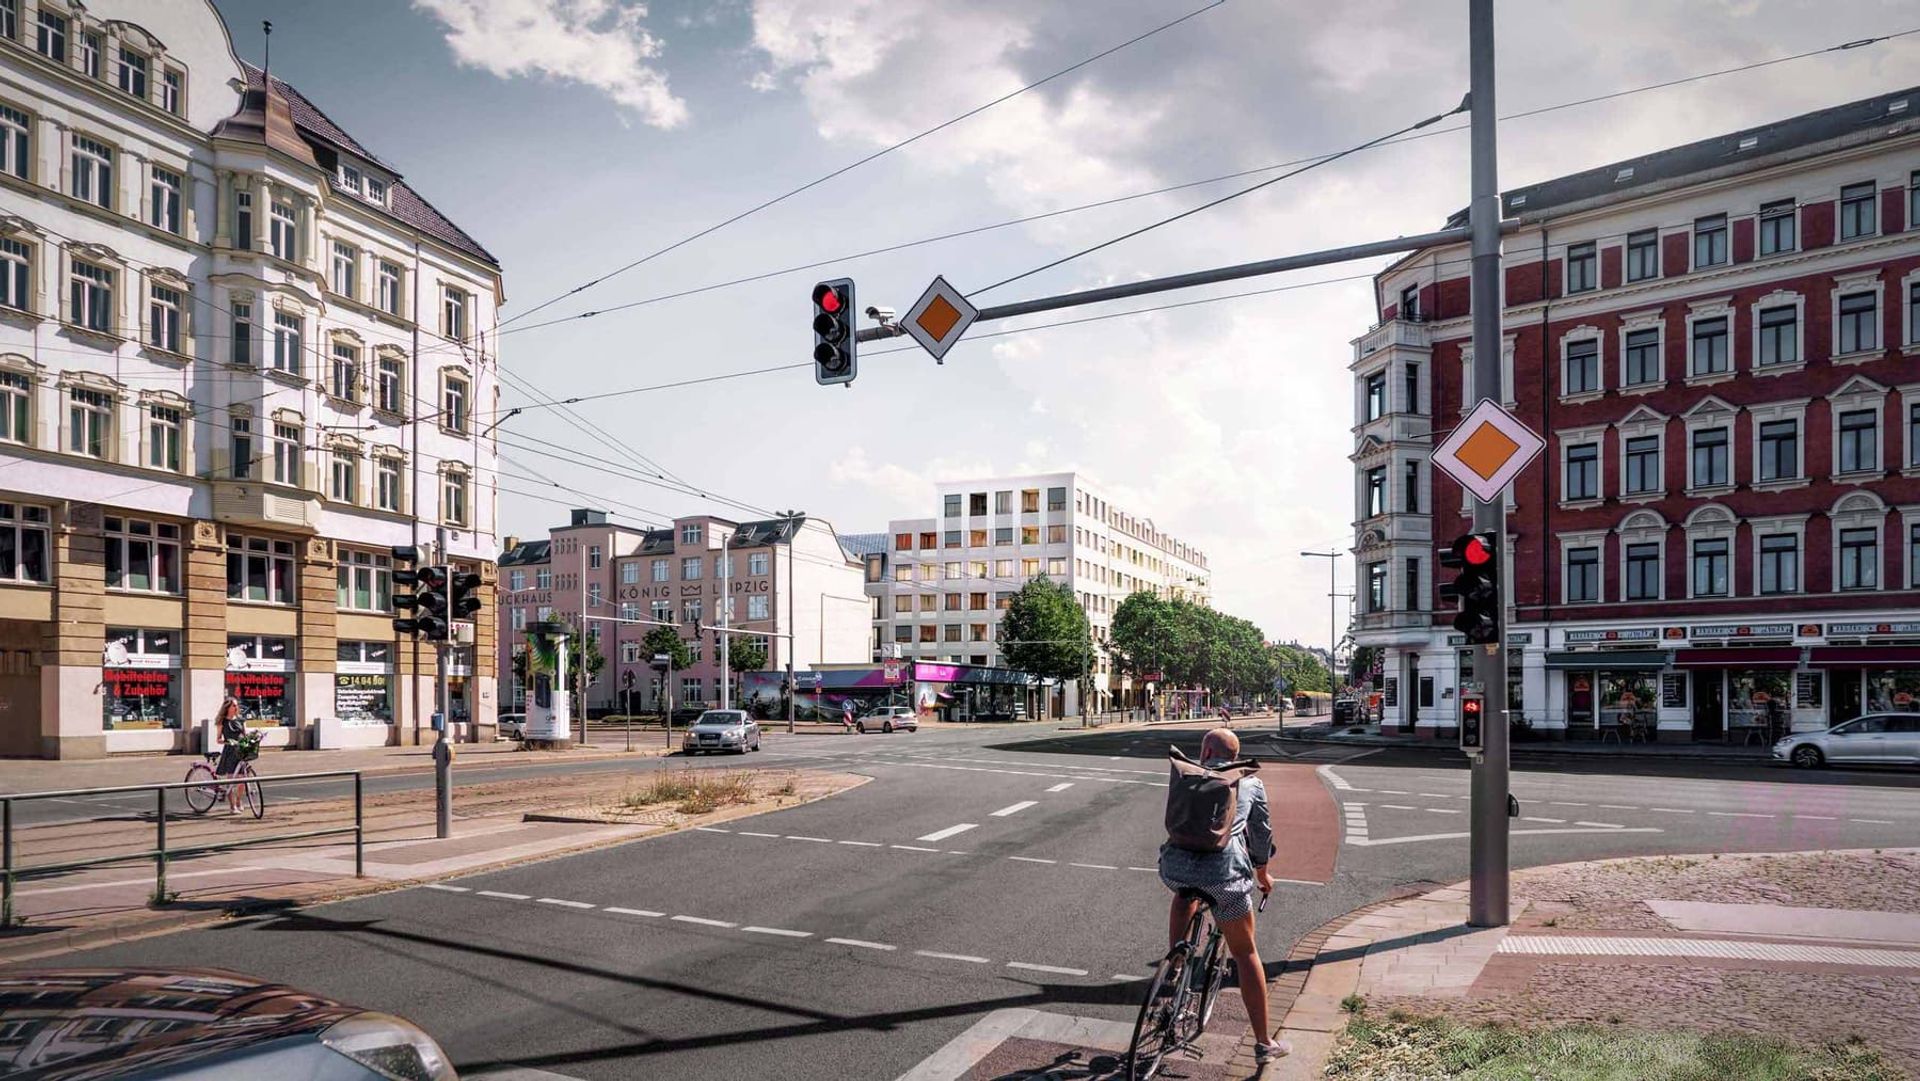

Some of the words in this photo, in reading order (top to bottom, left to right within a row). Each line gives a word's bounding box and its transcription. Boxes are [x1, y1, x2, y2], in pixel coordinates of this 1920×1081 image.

[619, 585, 671, 599] KÖNIG
[712, 580, 769, 595] LIPZIG
[124, 682, 168, 695] Zubehör
[244, 687, 283, 698] Zubehör
